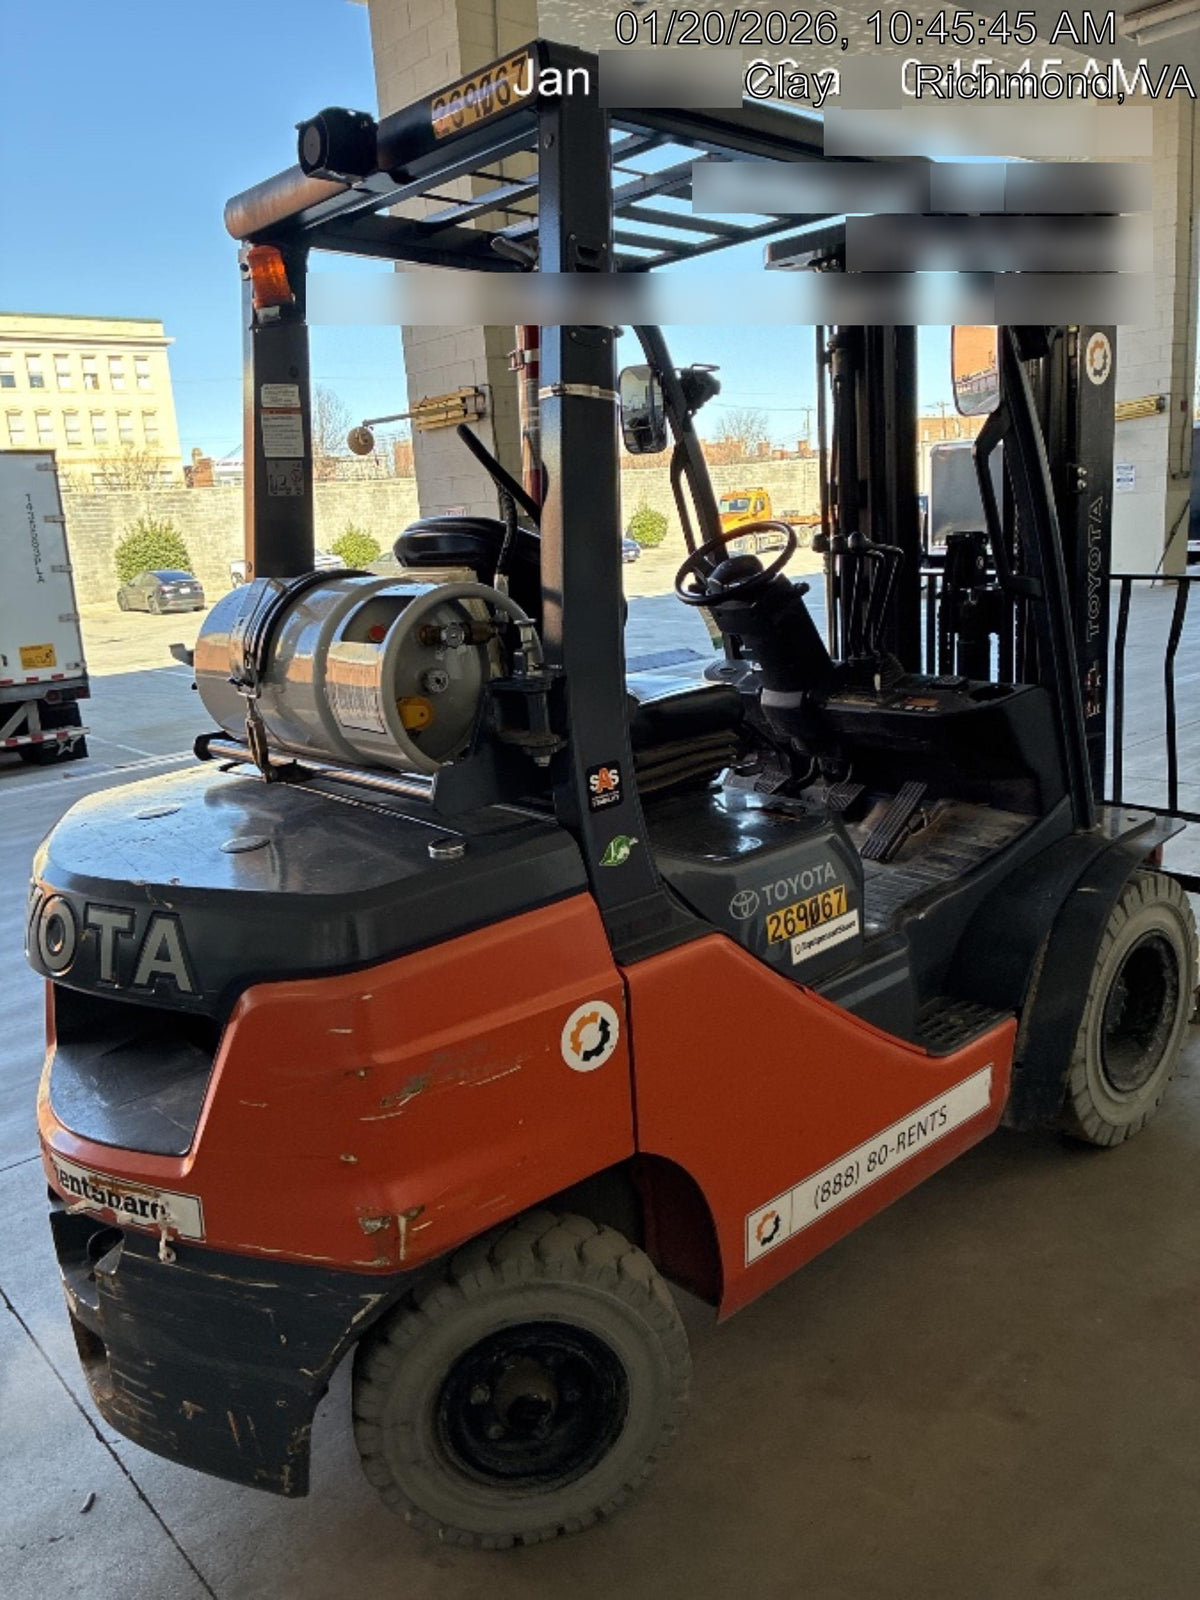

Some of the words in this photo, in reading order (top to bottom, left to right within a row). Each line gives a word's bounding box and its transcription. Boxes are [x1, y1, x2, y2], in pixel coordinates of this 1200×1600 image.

[1086, 496, 1103, 643] TOYOTA
[762, 862, 837, 905] TOYOTA
[769, 889, 844, 942] 269067
[814, 1161, 860, 1209] (888)
[866, 1105, 948, 1174] 80-RENTS
